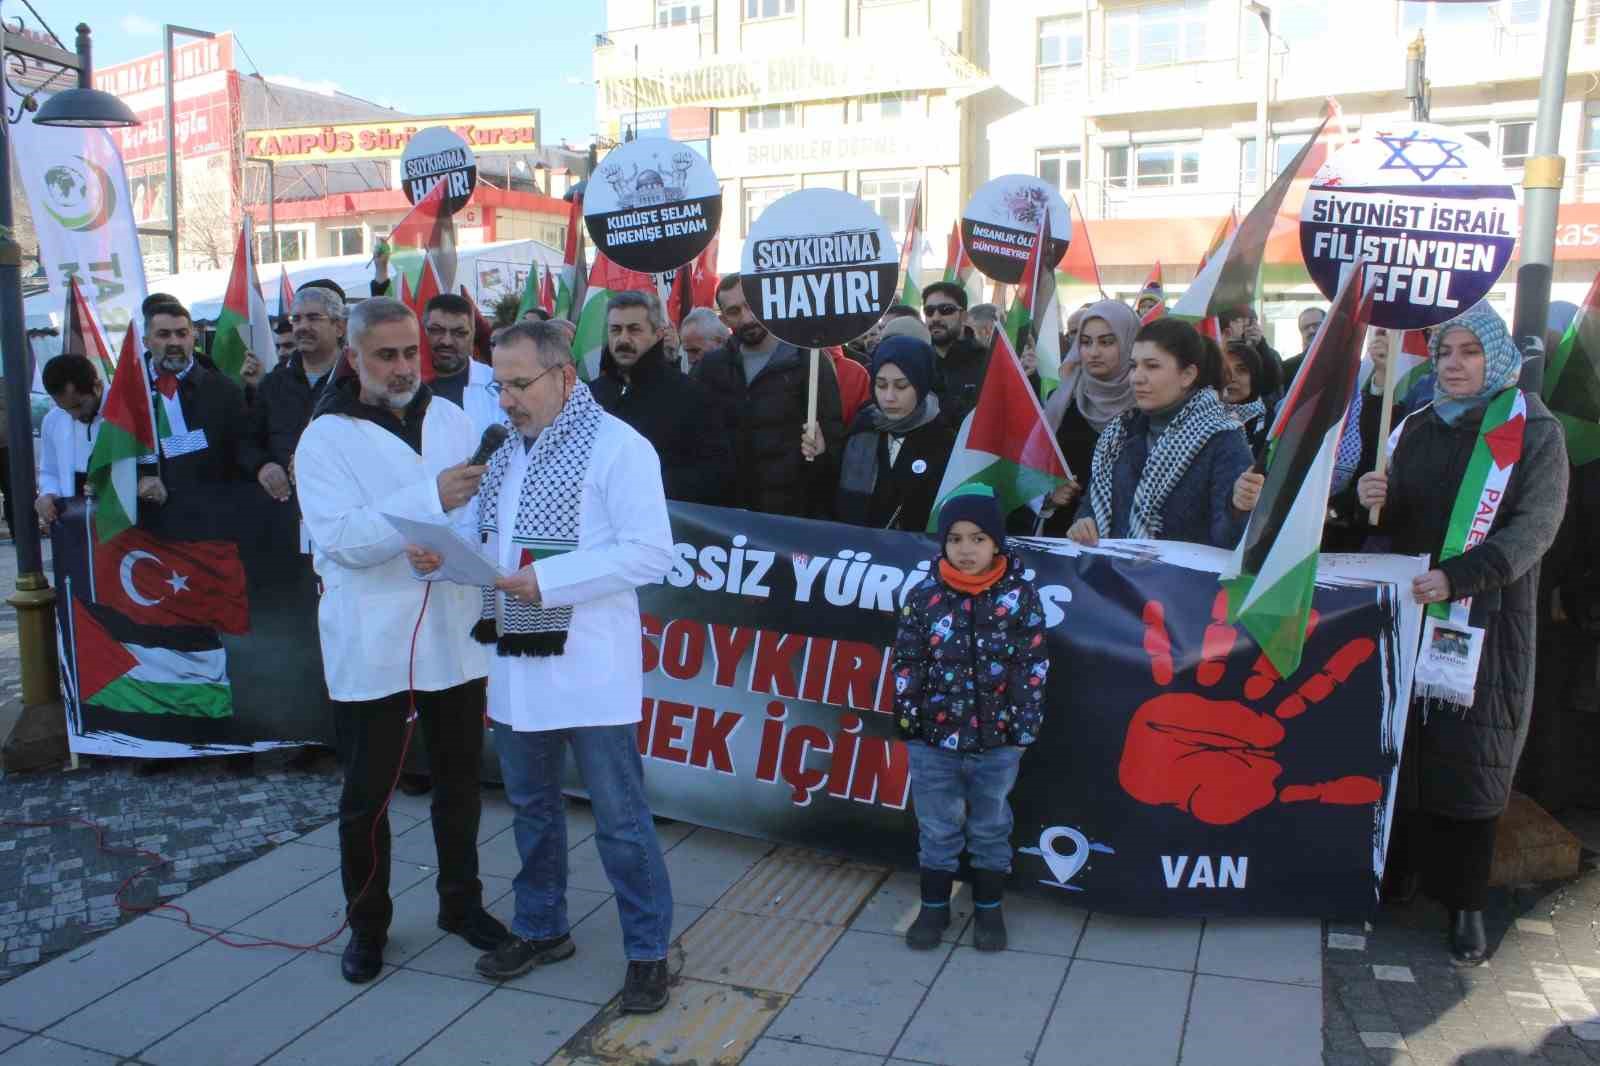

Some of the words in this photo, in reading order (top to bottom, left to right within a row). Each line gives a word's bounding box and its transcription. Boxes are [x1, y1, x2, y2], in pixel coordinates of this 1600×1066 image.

[246, 127, 354, 156] KAMPÜS
[456, 125, 536, 146] Kursu
[407, 148, 465, 177] SOYKIRIMA
[660, 202, 702, 221] SELAM
[1312, 195, 1425, 229] SİYONİST
[1430, 203, 1510, 236] İSRAİL
[606, 225, 663, 247] DİRENİŞE
[664, 218, 708, 237] DEVAM
[758, 232, 876, 268] SOYKIRIMA
[972, 223, 1016, 245] İNSANLIK
[1312, 227, 1497, 273] FİLİSTİN'DEN
[761, 270, 881, 321] HAYIR!
[657, 534, 776, 598] SSİZ
[755, 700, 911, 810] İÇİN
[1160, 855, 1249, 889] VAN
